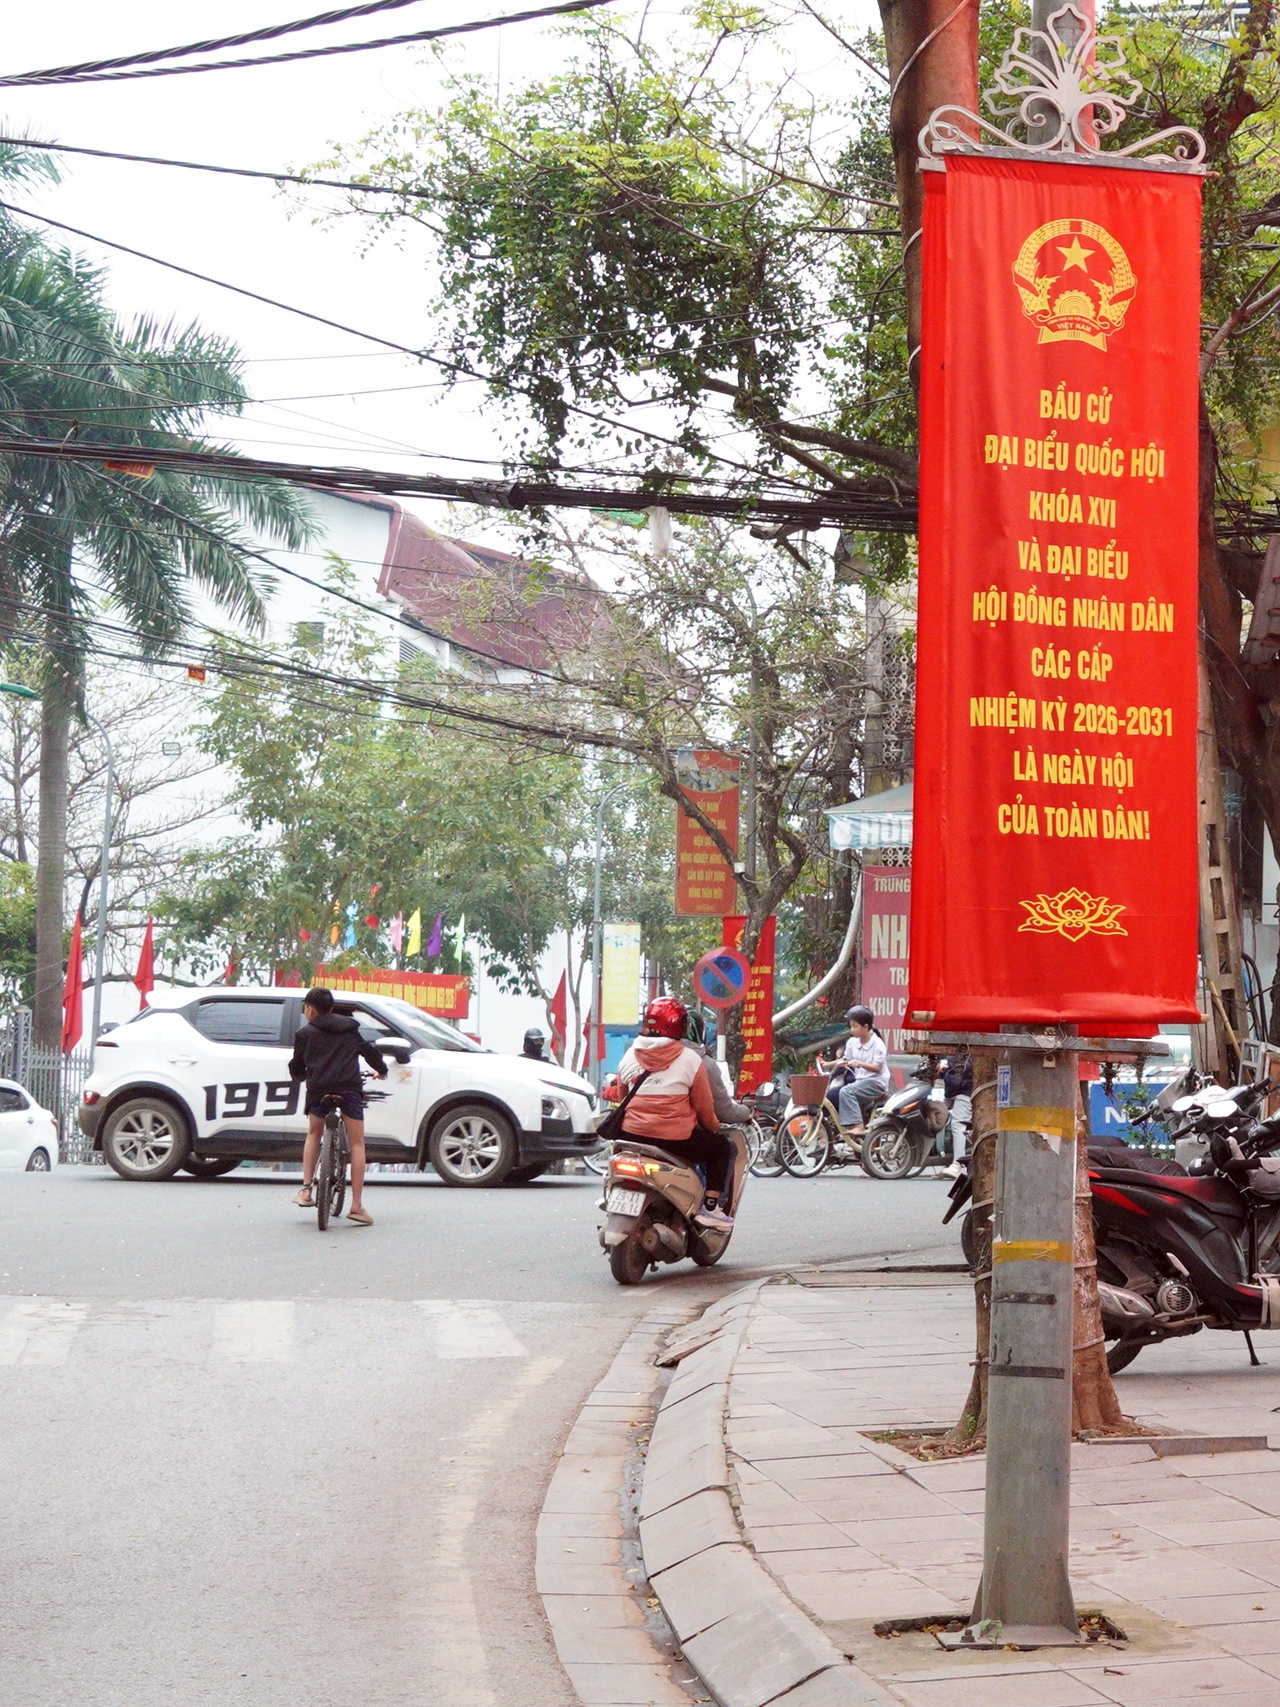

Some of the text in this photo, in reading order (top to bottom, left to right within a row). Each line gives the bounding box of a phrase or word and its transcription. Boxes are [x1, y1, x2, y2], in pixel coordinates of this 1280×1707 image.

[1075, 323, 1092, 332] NAM
[1040, 380, 1113, 425] BẦU CỬ
[985, 430, 1165, 483] ĐẠI BIỂU QUỐC HỘI
[1029, 488, 1116, 528] KHÓA XVI
[1018, 535, 1129, 581] VÀ ĐẠI BIỂU
[973, 585, 1174, 632] HỘI ĐỒNG NHÂN DÂN
[1032, 642, 1113, 682] CÁC CẤP
[970, 692, 1173, 737] NHIỆM KỲ 2026-2031
[1014, 745, 1134, 793] LÀ NGÀY HỘI
[998, 794, 1150, 840] CỦA TOÀN DÂN!
[874, 877, 911, 892] TRUNG
[871, 914, 909, 959] NH
[869, 997, 894, 1016] KHU
